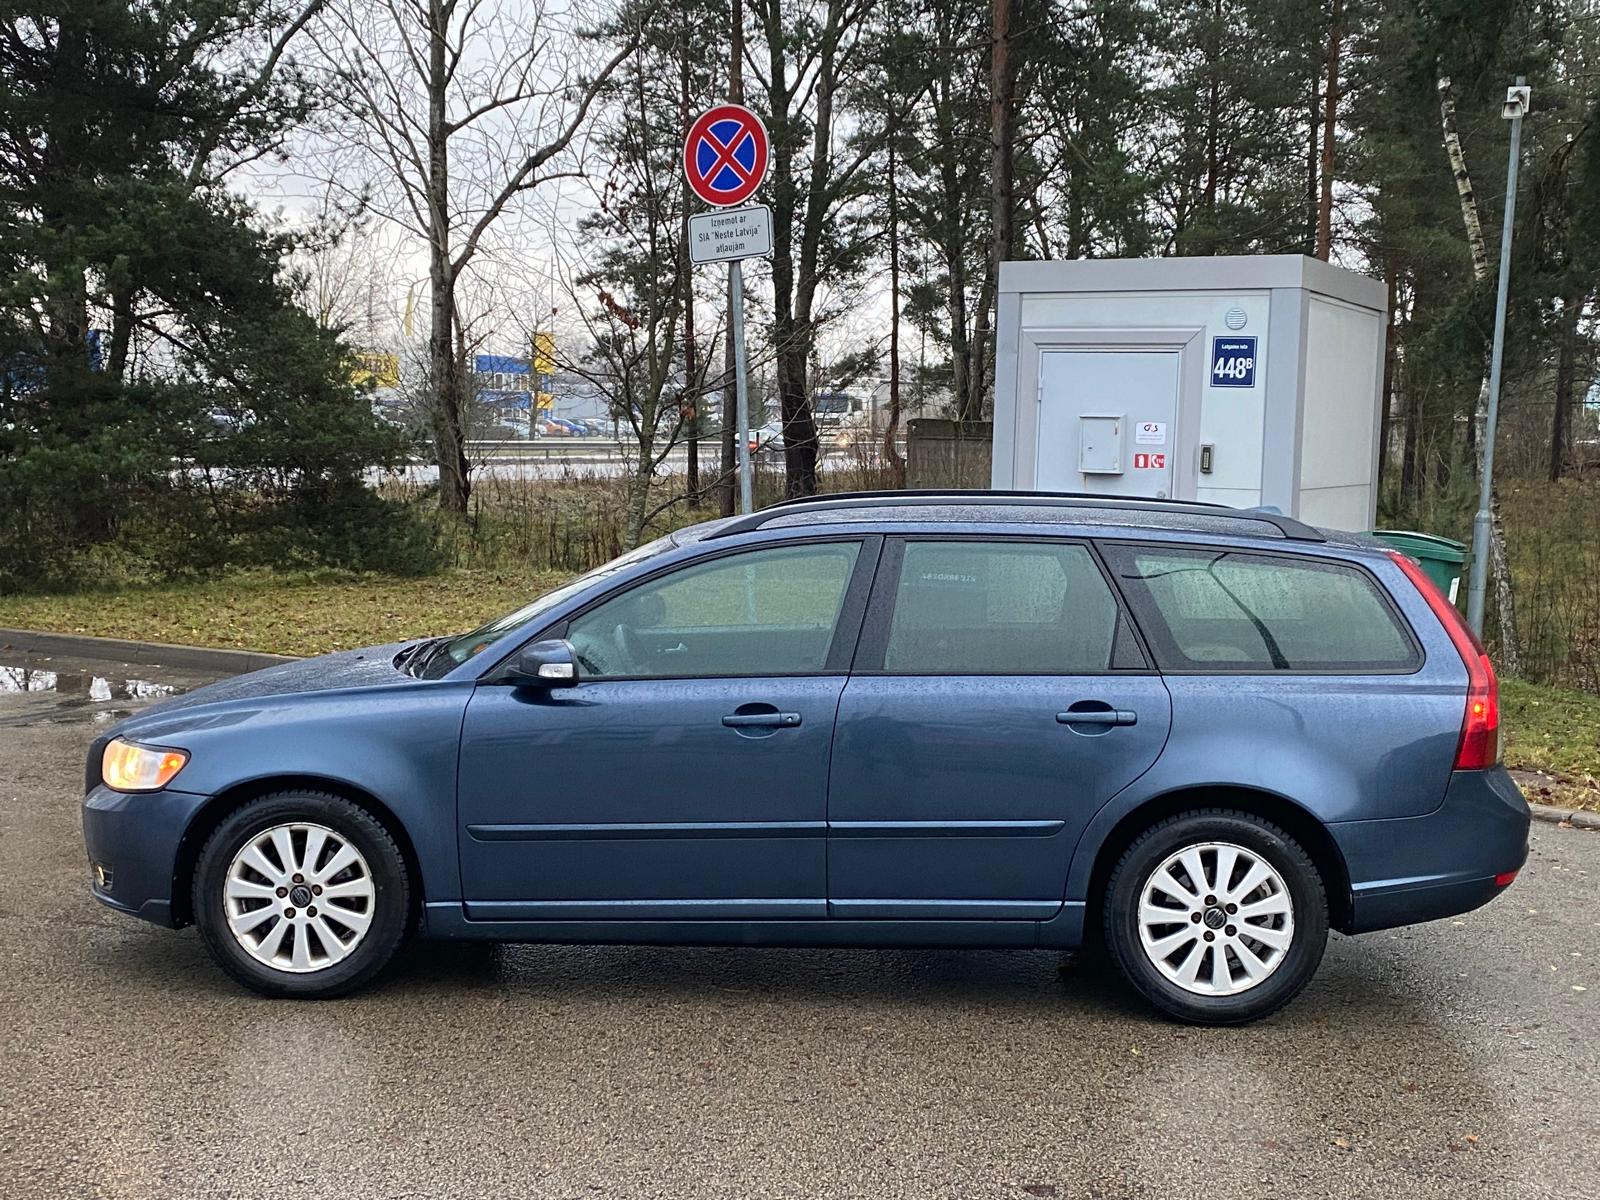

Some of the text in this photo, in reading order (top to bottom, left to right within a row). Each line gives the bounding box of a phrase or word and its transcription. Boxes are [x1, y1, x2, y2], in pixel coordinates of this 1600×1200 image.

[711, 216, 738, 228] Izņemot
[698, 224, 760, 242] SIA "Neste Latvija"
[716, 242, 745, 253] atļaujām
